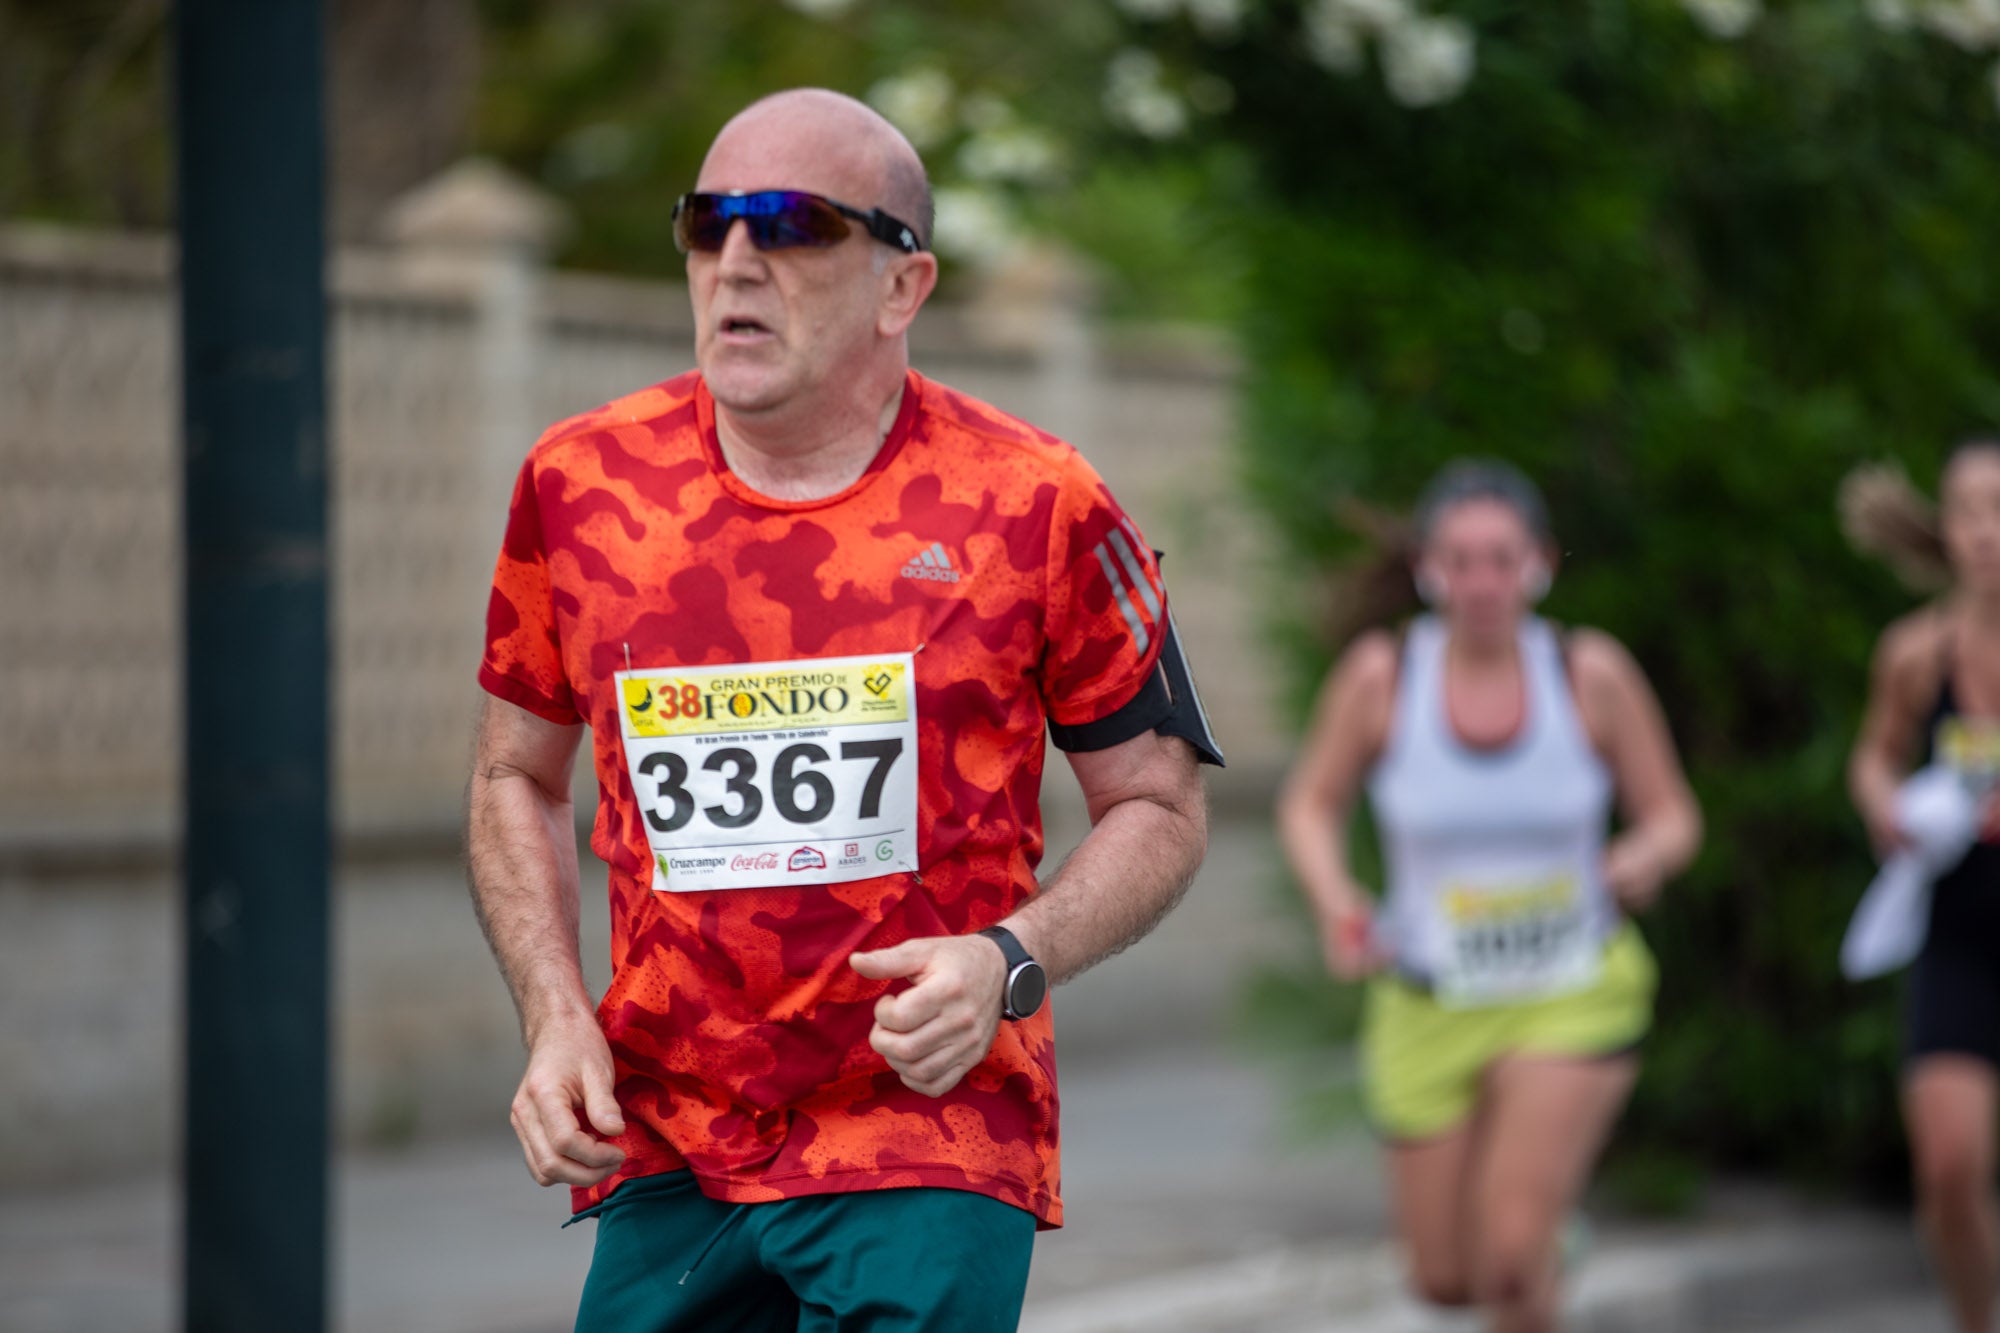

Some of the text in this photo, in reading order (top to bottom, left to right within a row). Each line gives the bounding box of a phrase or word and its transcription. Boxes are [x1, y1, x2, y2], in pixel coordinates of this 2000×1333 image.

[900, 566, 959, 583] adidas
[711, 677, 760, 692] GRAN
[767, 672, 834, 689] PREMIO
[658, 684, 849, 720] 38 FONDO
[638, 737, 903, 833] 3367
[670, 857, 726, 869] Cruzcampo
